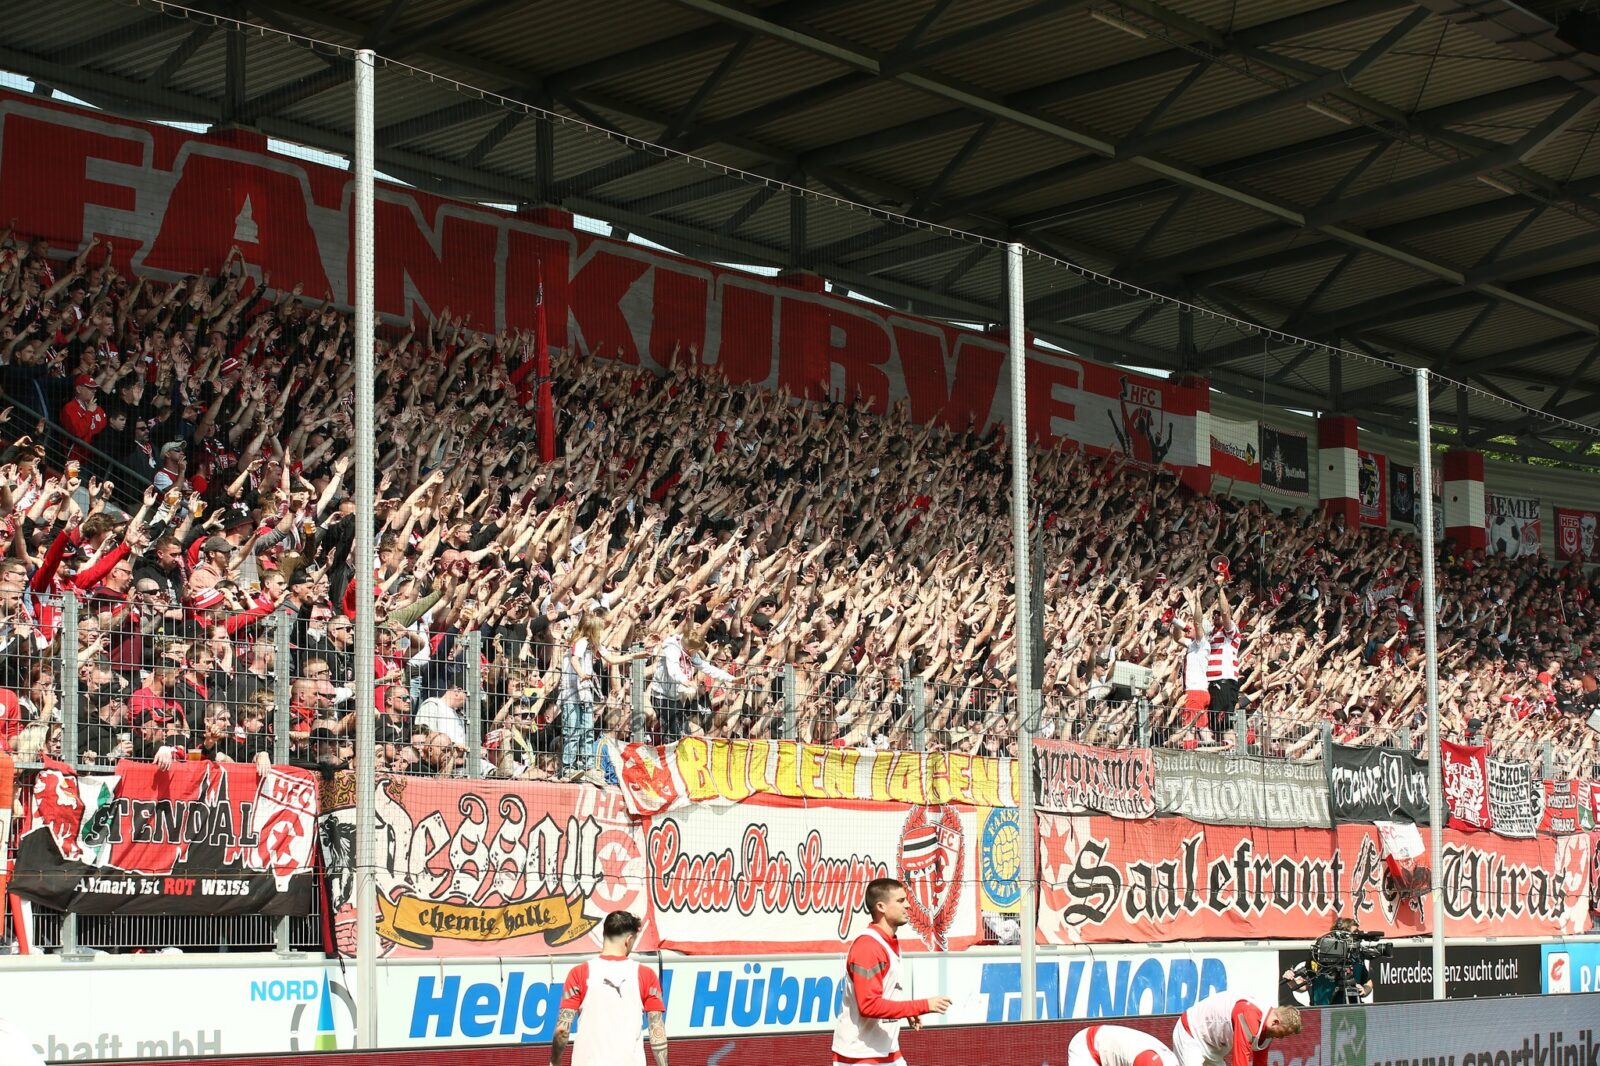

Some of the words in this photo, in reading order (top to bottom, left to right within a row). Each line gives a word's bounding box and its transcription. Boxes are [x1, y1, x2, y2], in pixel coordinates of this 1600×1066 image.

[0, 104, 1098, 458] FANKURVE
[1130, 385, 1157, 406] HFC
[1561, 516, 1580, 528] HFC
[676, 736, 860, 802] BULLEN
[272, 777, 314, 808] HFC
[84, 788, 259, 847] STENDAL
[648, 817, 734, 912] Coesa
[738, 823, 793, 917] Per
[1063, 832, 1344, 927] Saalefront
[1442, 845, 1568, 922] Ultras
[140, 878, 160, 895] ist
[164, 878, 196, 895] ROT
[201, 878, 250, 895] WEISS
[418, 905, 498, 935] chemie
[503, 903, 552, 936] halle
[1463, 963, 1493, 982] sucht
[1495, 958, 1519, 981] dich!
[250, 981, 319, 1001] NORD
[690, 963, 846, 1028] Hübn
